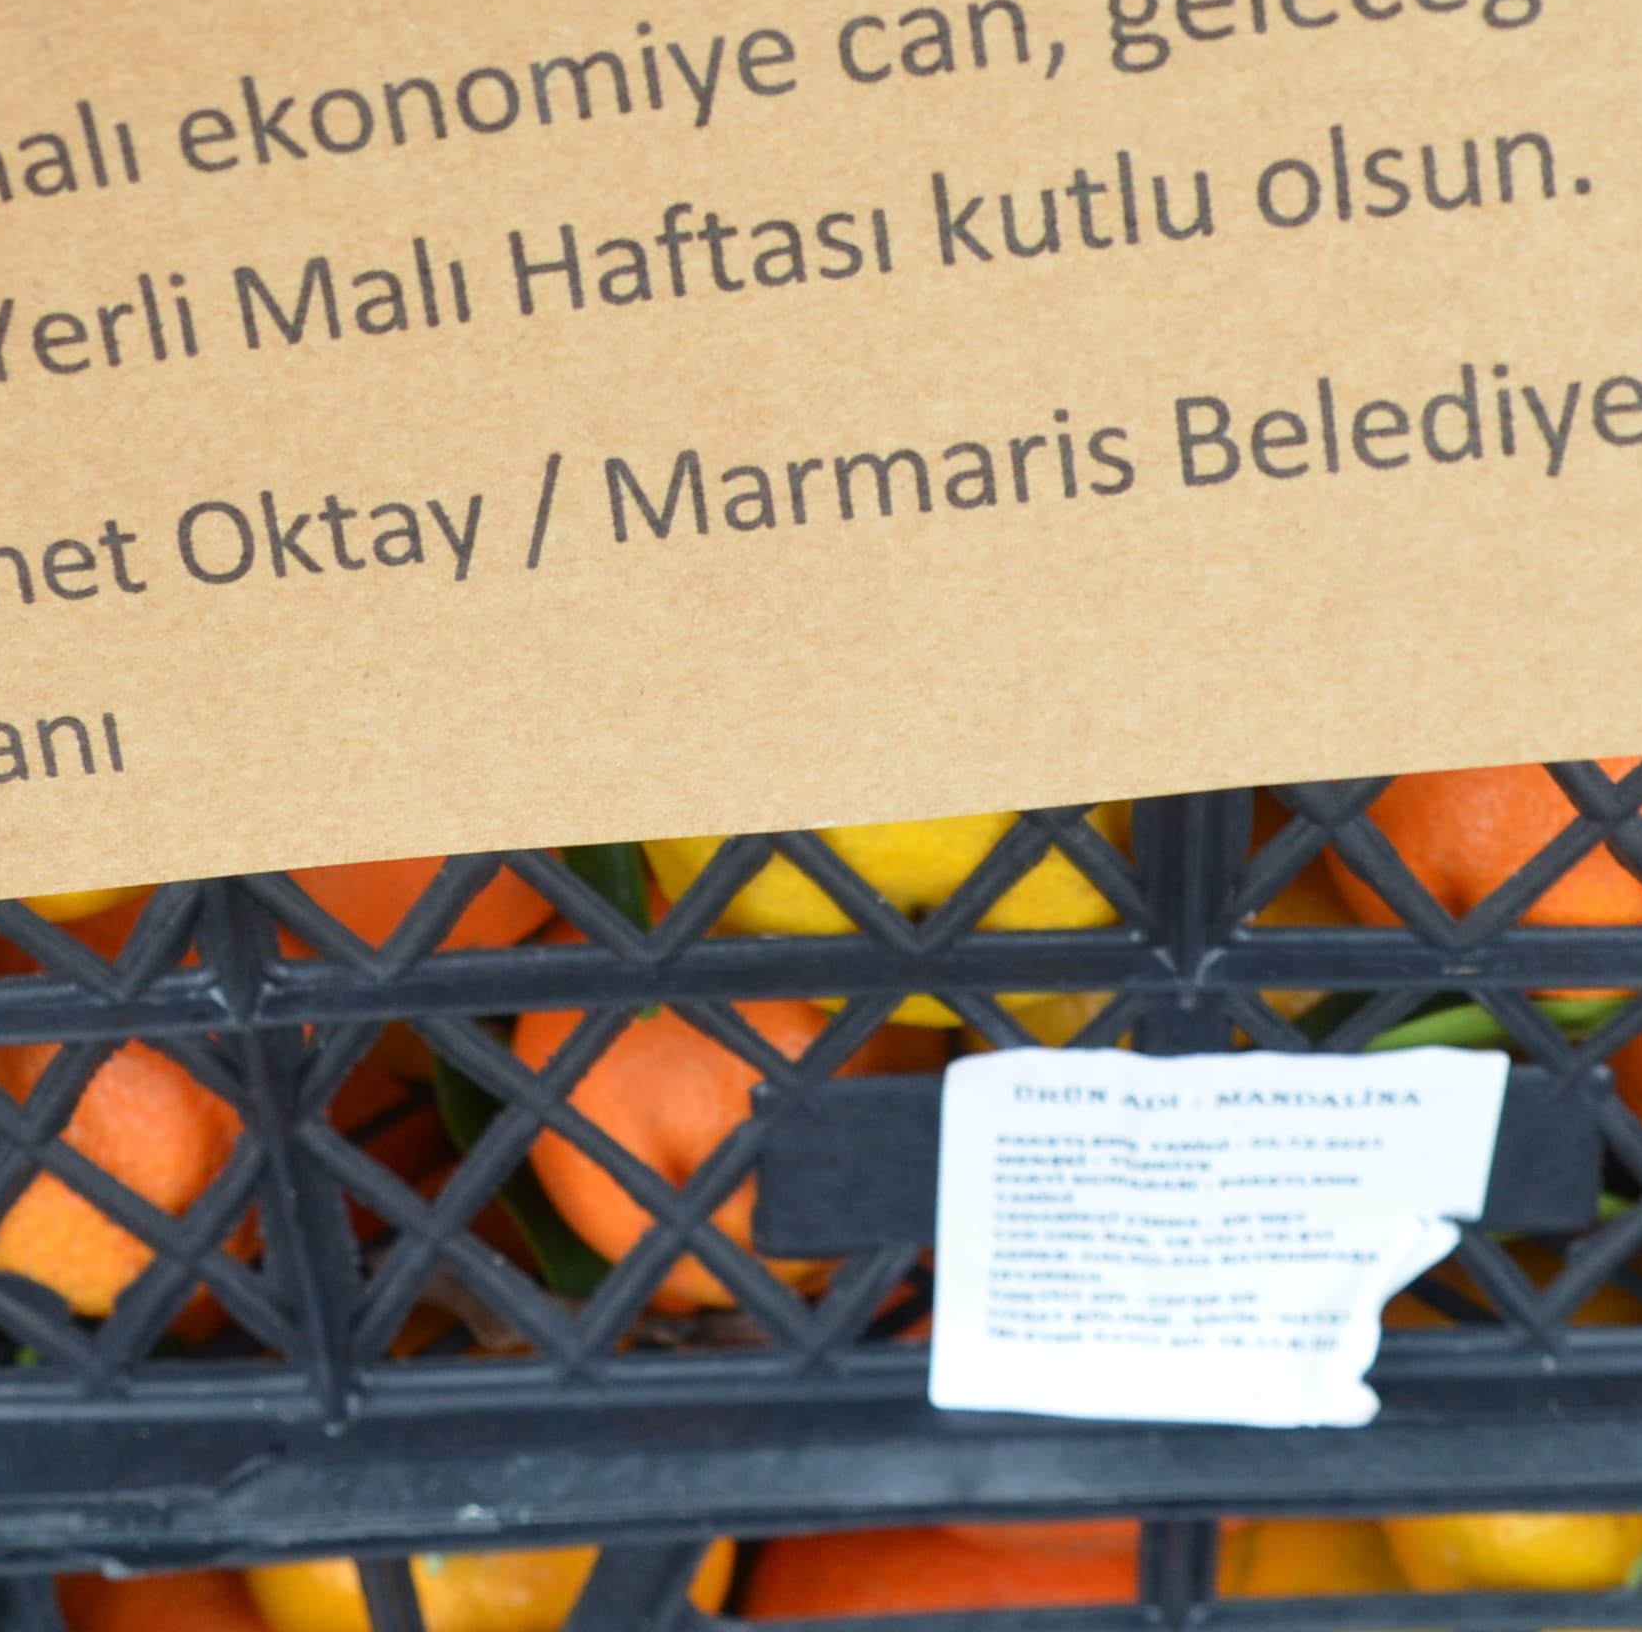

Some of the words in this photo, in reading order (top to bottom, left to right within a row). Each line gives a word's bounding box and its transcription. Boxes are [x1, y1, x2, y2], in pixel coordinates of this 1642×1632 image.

[179, 21, 796, 174] ekonomiye
[233, 236, 472, 350] Malı
[508, 201, 893, 316] Haftası
[931, 150, 1214, 266] kutlu
[1256, 125, 1591, 228] olsun.
[176, 489, 483, 585] Oktay
[526, 452, 562, 570] /
[604, 408, 1135, 544] Marmaris
